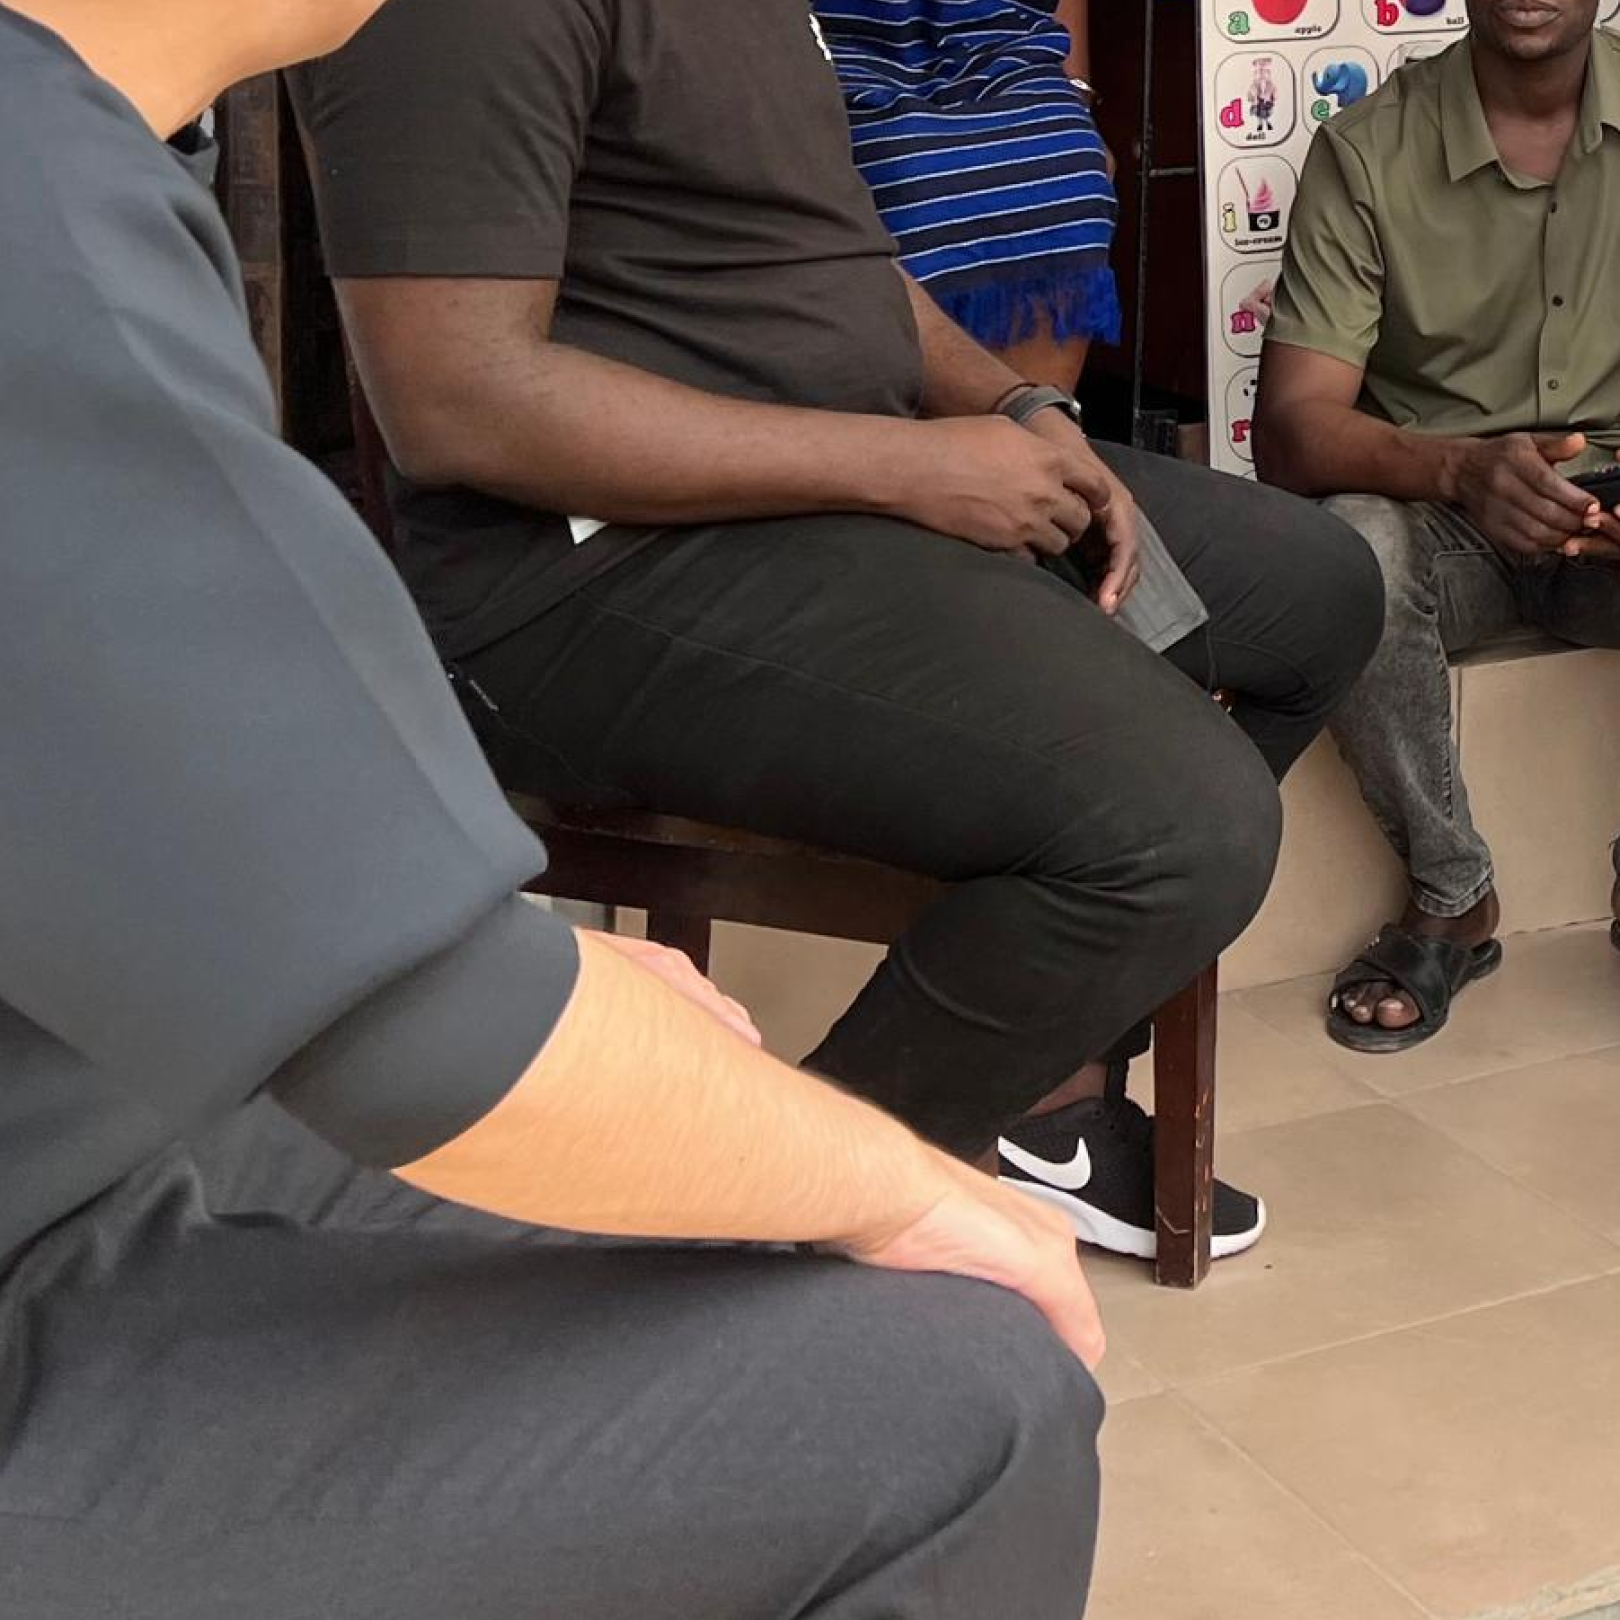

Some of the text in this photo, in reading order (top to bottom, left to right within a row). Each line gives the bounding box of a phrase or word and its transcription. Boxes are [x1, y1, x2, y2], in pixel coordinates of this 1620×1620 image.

[1228, 11, 1250, 35] a
[1220, 98, 1245, 129] d
[1311, 99, 1331, 122] e
[1222, 201, 1238, 233] i
[1230, 310, 1257, 334] n
[1231, 419, 1252, 443] r
